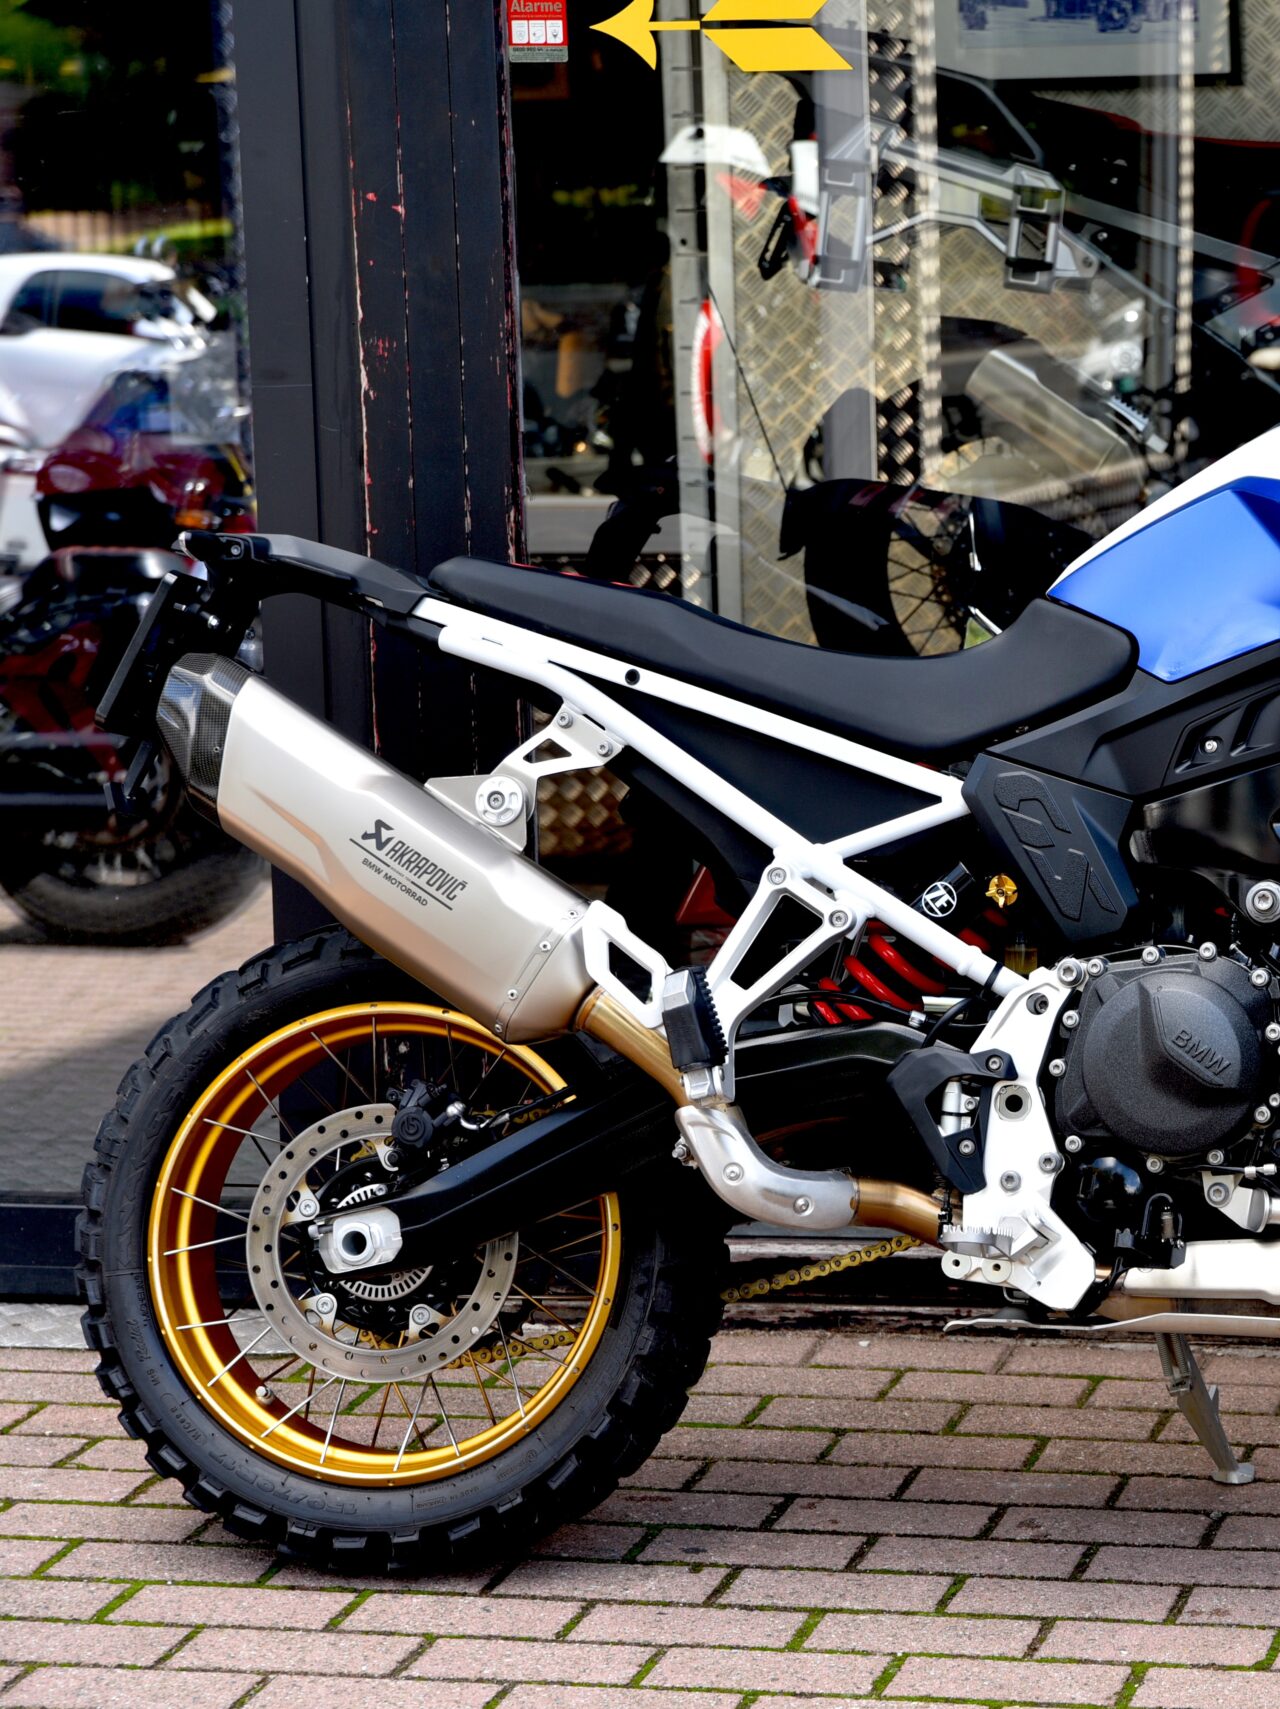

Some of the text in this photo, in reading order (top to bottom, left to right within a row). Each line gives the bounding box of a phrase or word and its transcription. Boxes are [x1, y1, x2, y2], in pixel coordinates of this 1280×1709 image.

[510, 0, 563, 13] Alarme
[361, 858, 384, 875] BMW
[383, 872, 429, 906] MOTORRAD
[385, 840, 469, 902] AKRAPOVIČ
[922, 881, 957, 917] ZF
[1171, 1029, 1232, 1076] BMW
